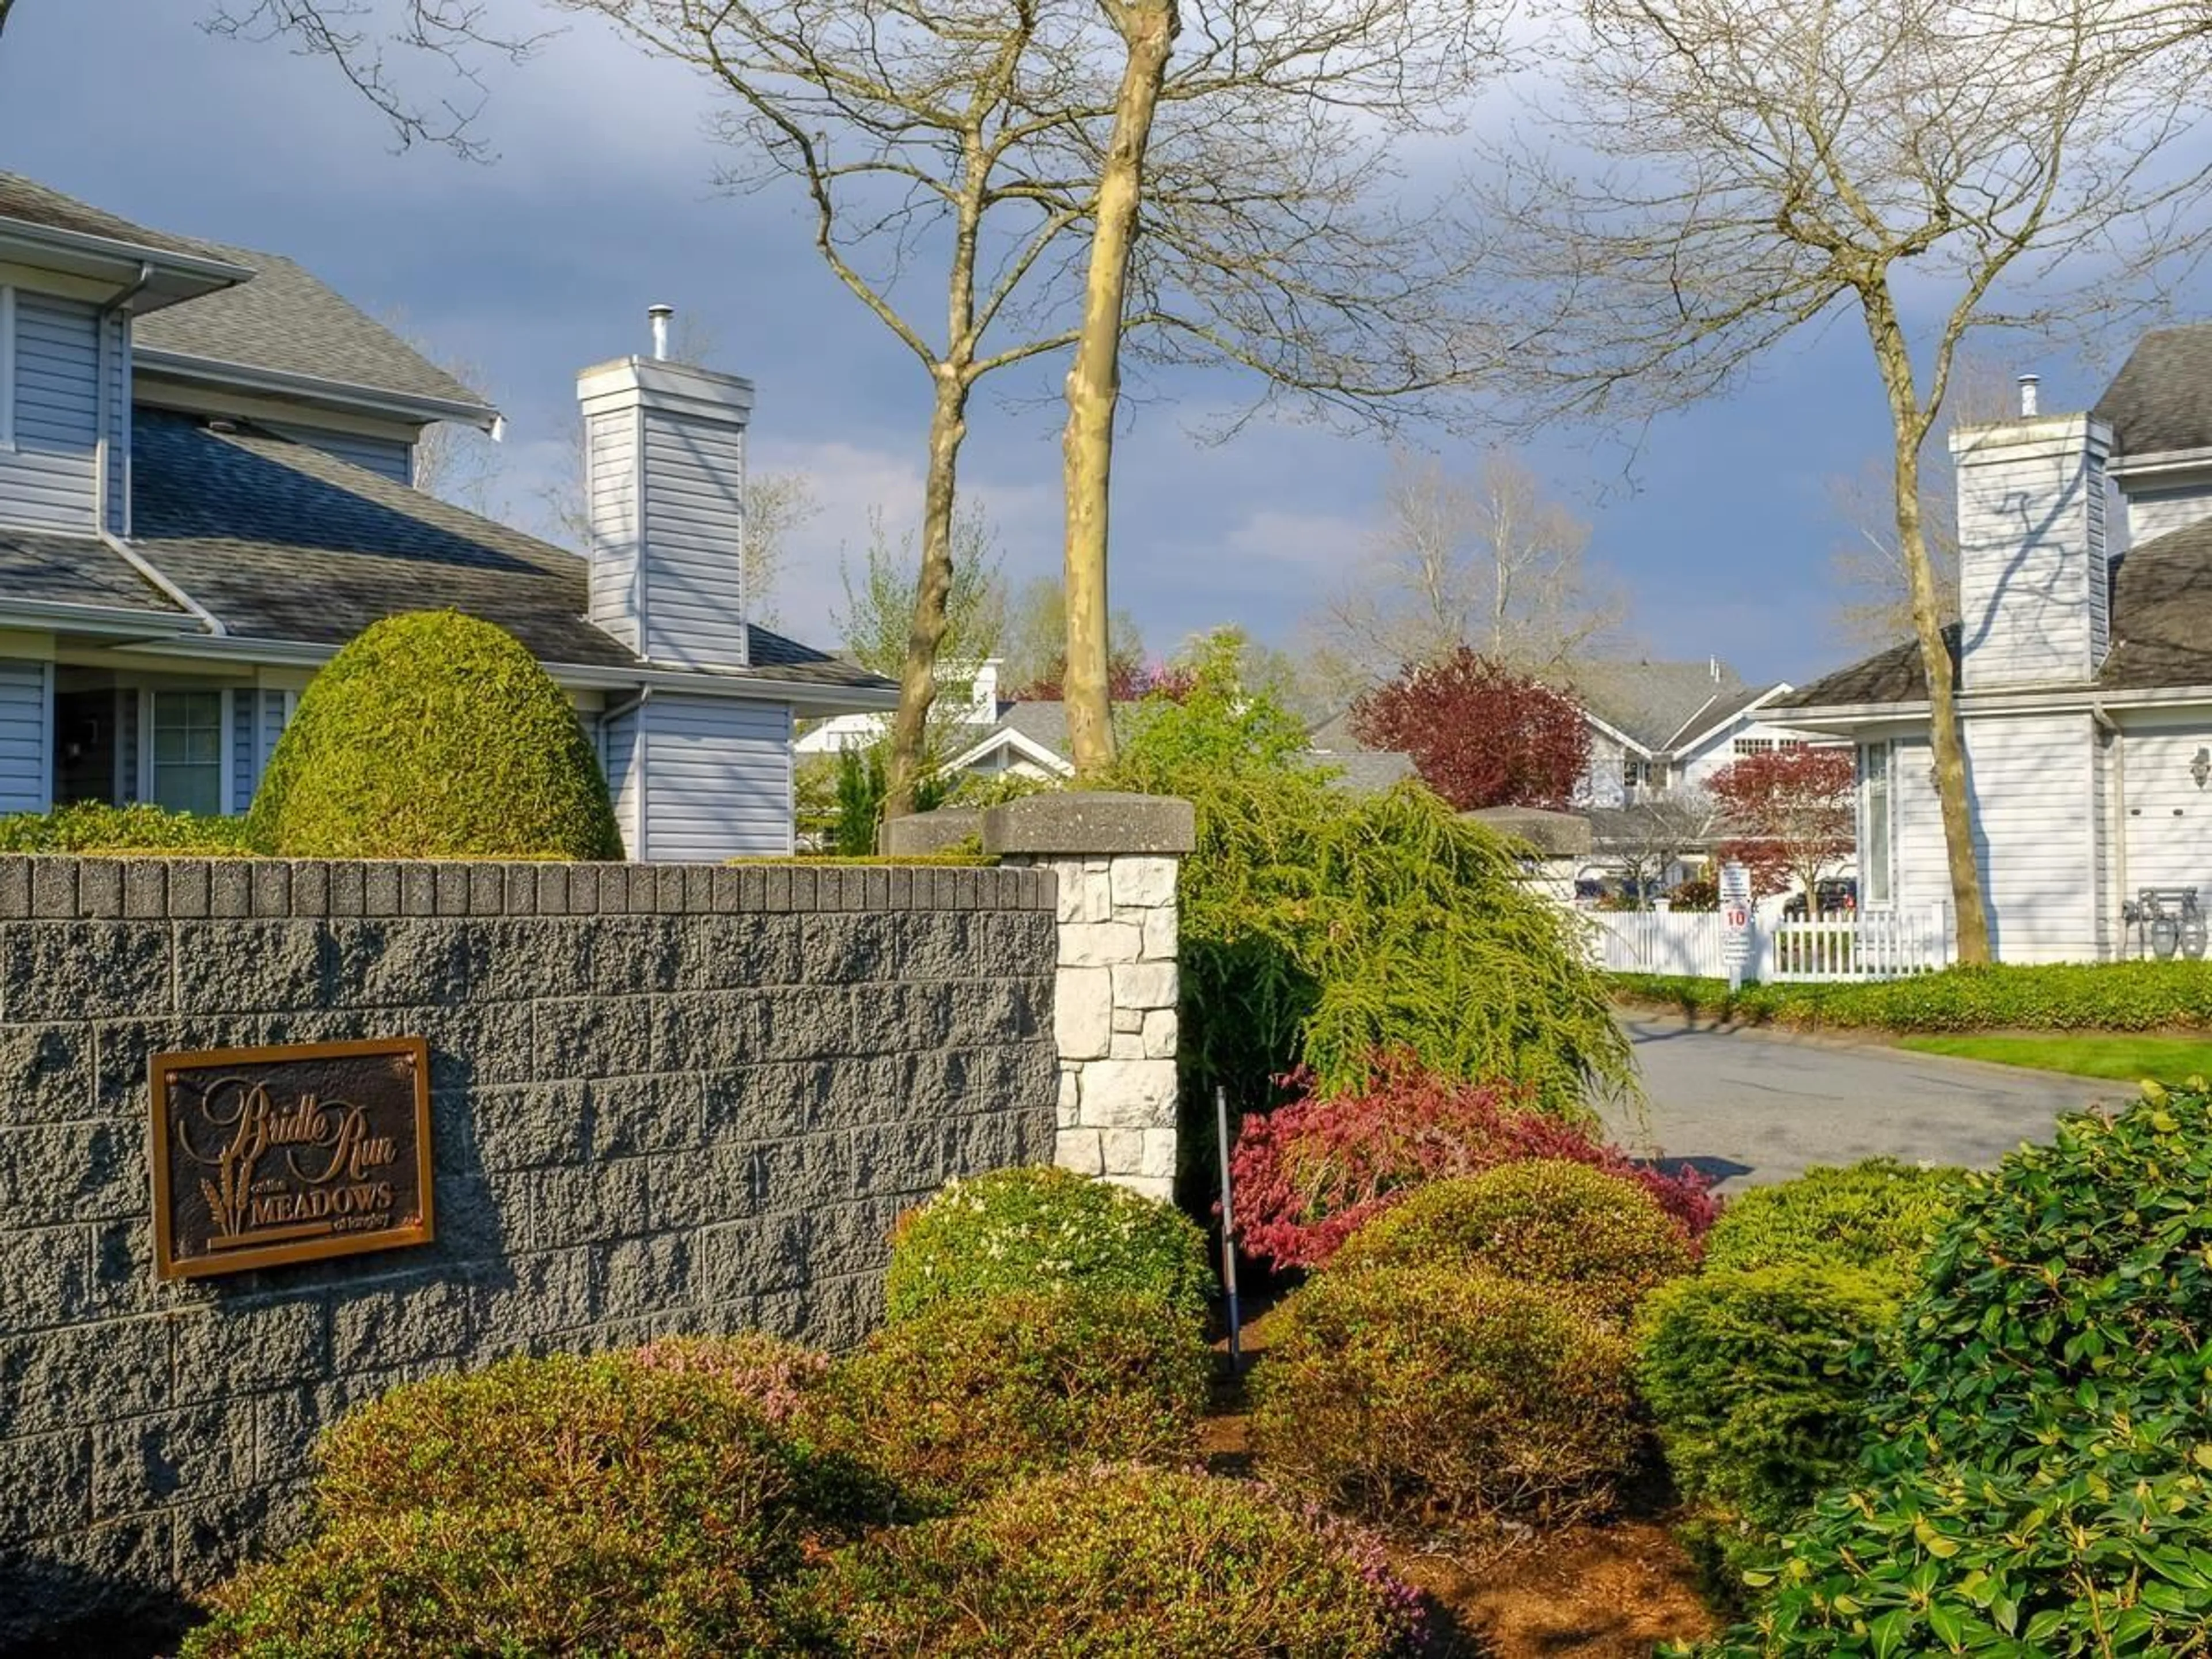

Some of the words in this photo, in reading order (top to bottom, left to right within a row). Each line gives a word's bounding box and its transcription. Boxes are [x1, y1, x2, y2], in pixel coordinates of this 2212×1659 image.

[1728, 911, 1745, 926] 10
[179, 1076, 329, 1164] Bridle
[287, 1100, 396, 1184] Run
[249, 1180, 392, 1226] MEADOWS
